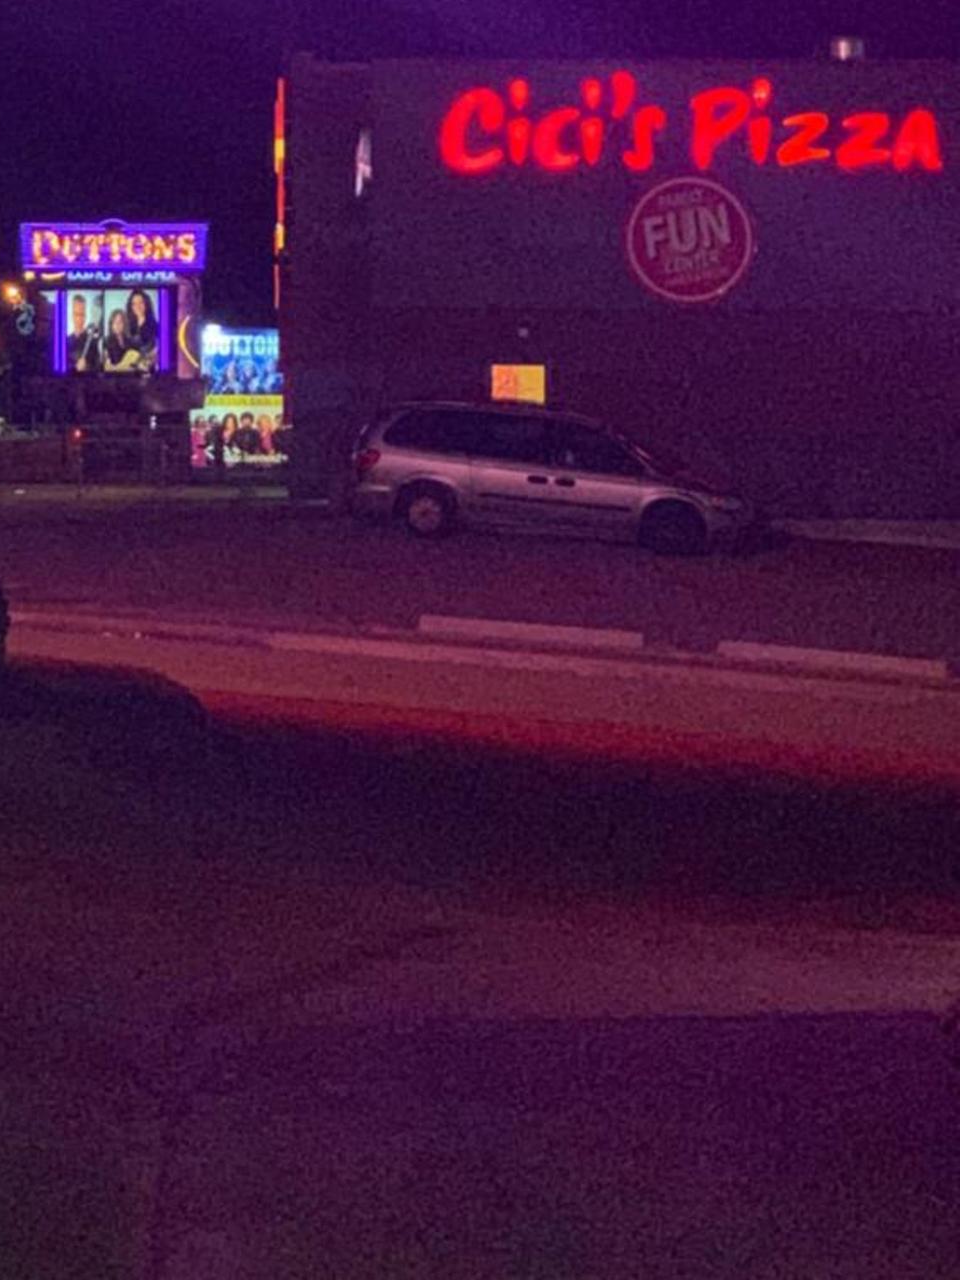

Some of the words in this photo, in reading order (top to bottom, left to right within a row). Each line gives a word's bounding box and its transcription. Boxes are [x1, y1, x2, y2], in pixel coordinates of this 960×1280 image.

[438, 70, 666, 173] Cici's
[689, 77, 943, 171] Pizza
[642, 202, 732, 260] FUN
